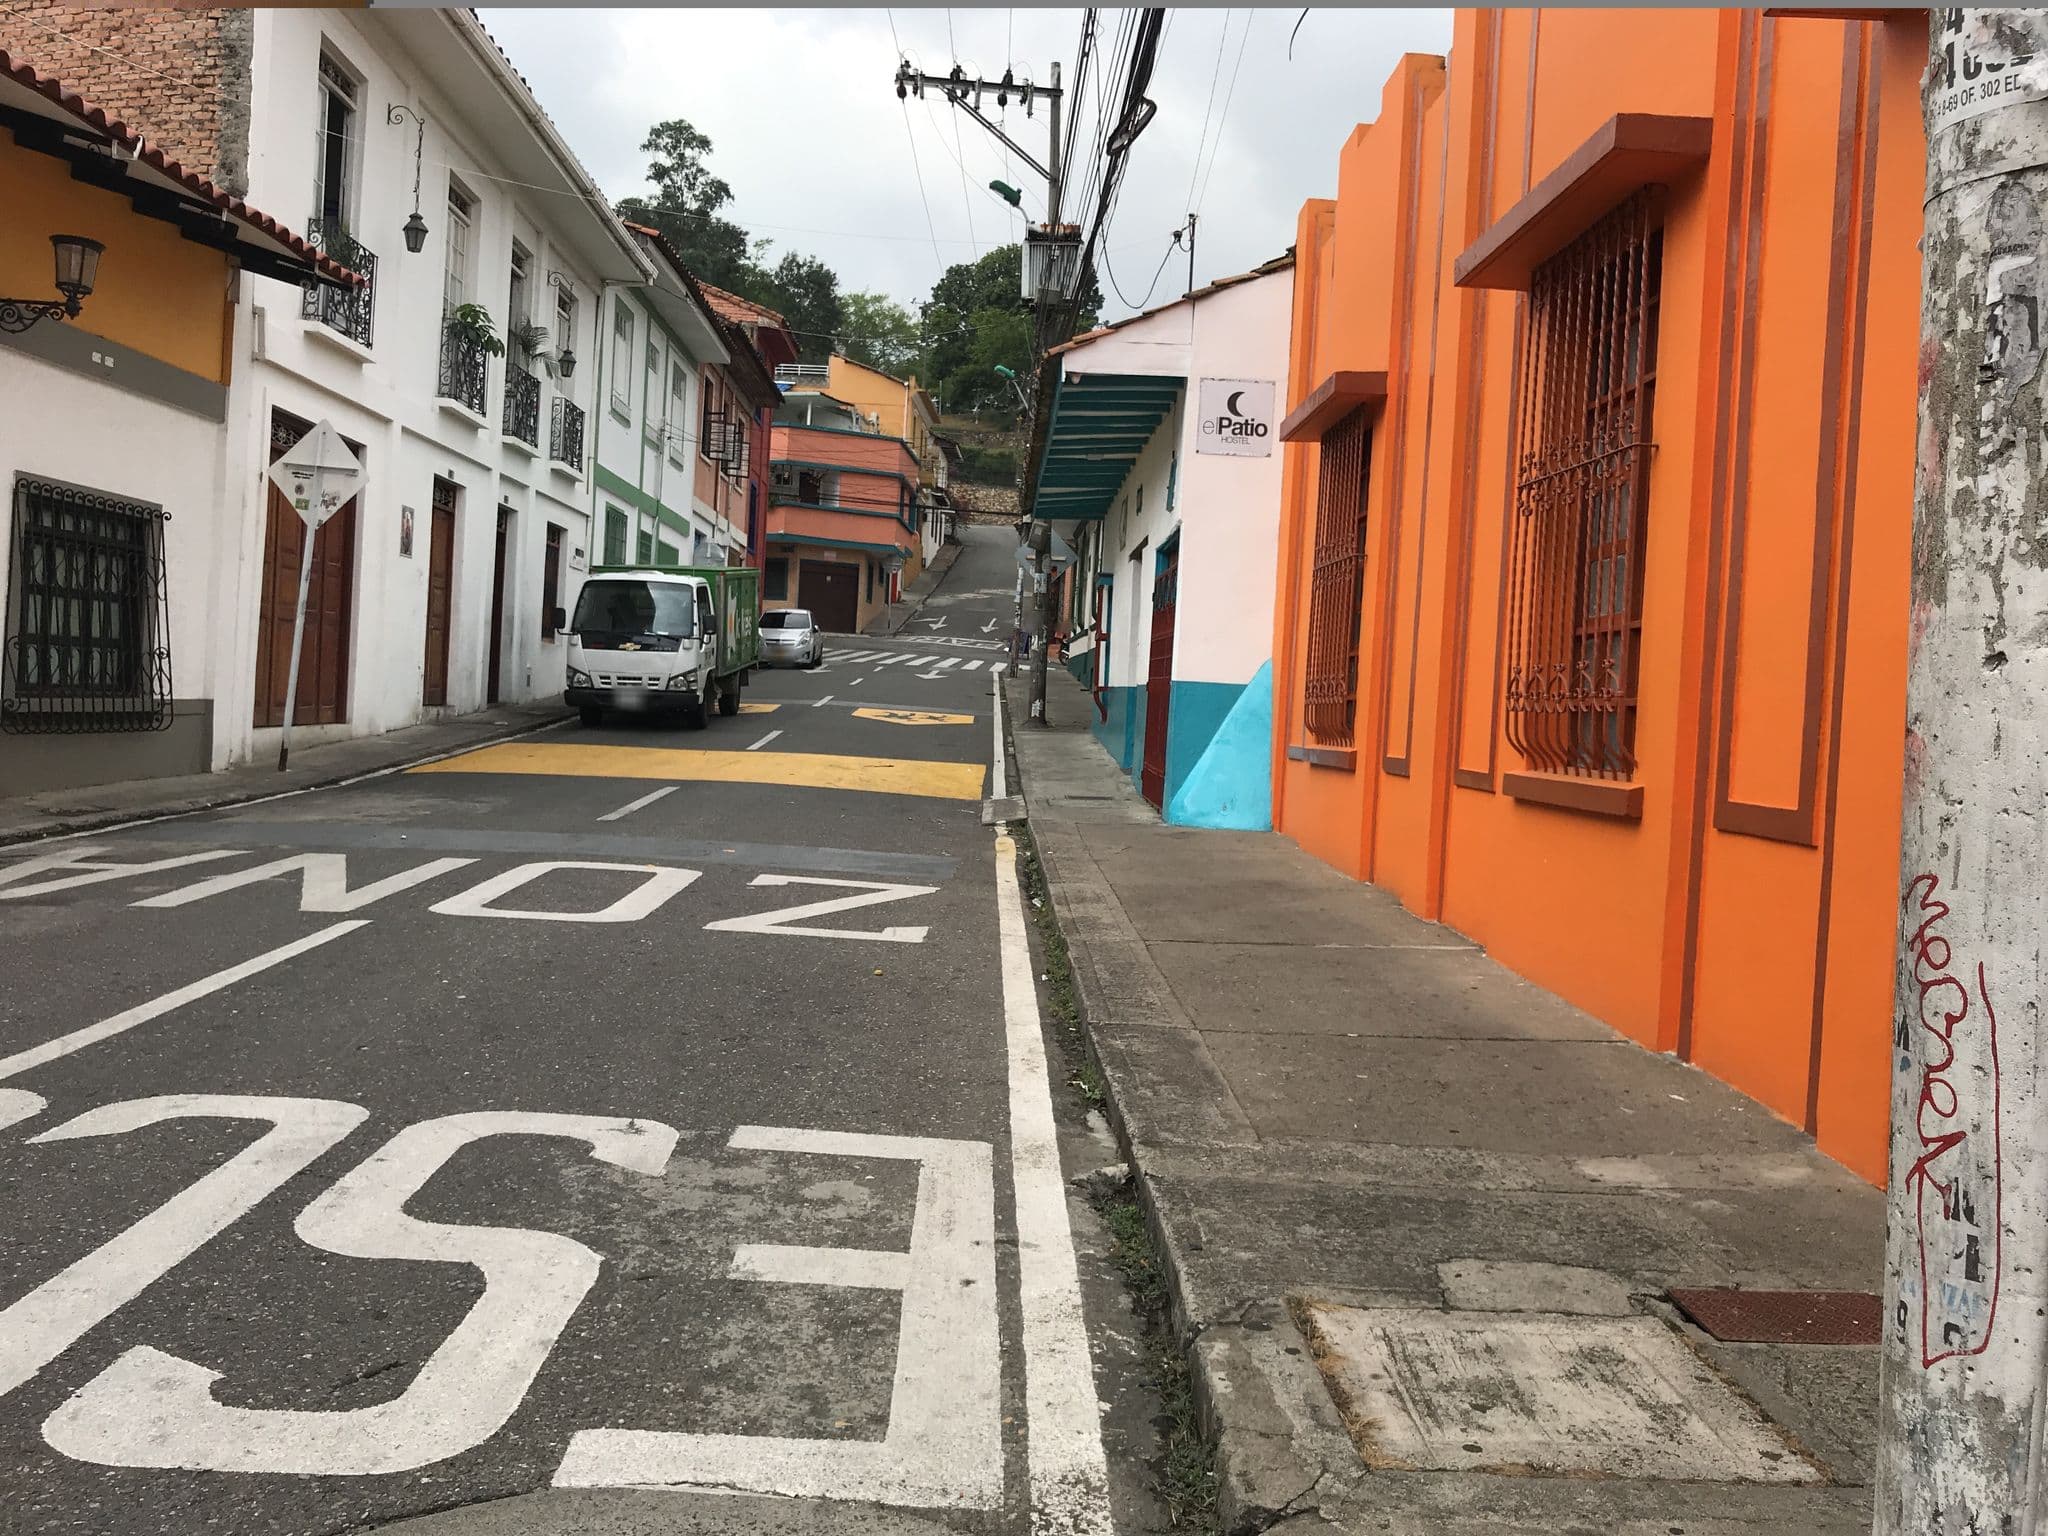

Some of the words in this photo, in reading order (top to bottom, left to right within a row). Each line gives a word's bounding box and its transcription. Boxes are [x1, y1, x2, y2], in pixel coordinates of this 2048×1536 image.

[1961, 87, 1976, 106] OF.
[1980, 79, 2001, 100] 302
[1219, 417, 1268, 437] Patio
[1221, 436, 1250, 445] HOSTEL
